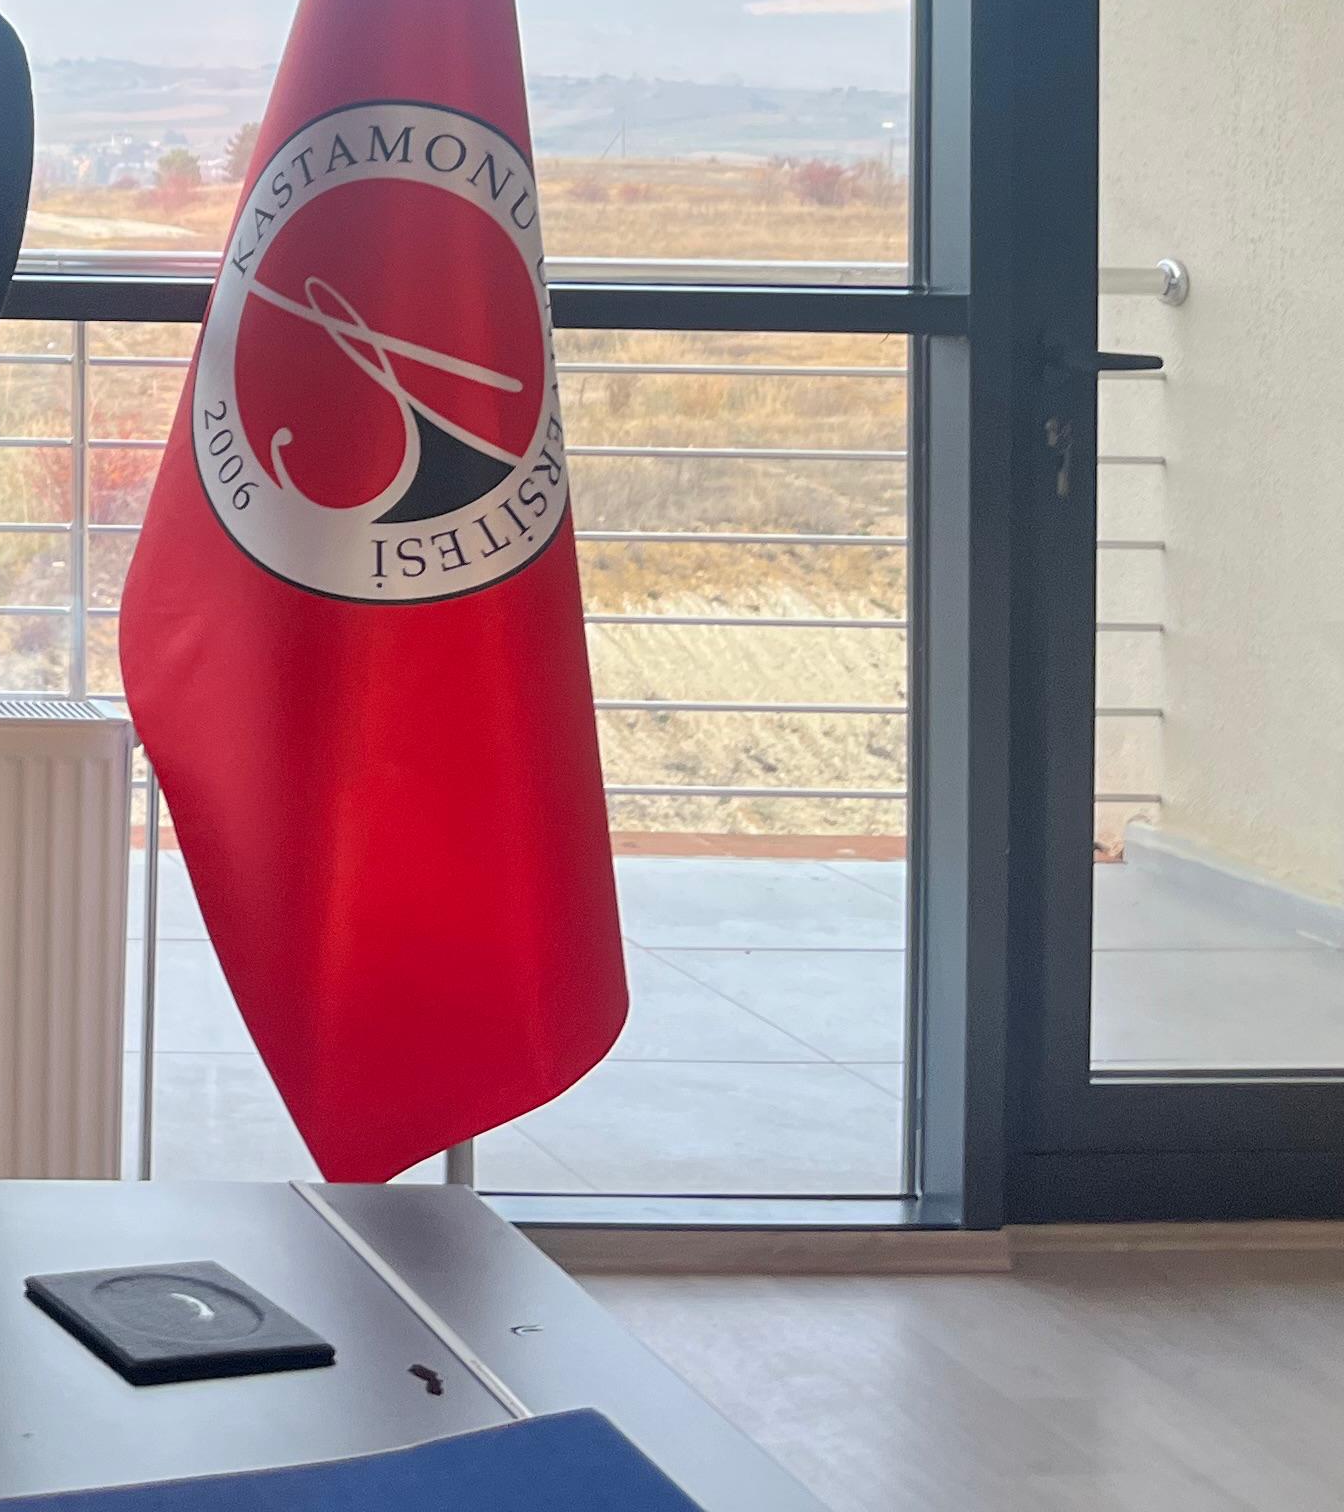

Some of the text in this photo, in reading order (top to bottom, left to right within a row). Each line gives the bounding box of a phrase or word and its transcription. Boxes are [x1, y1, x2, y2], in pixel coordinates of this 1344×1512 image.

[231, 124, 537, 277] KASTAMONU
[203, 400, 259, 511] 2006
[370, 254, 564, 588] ERSİTESİ
